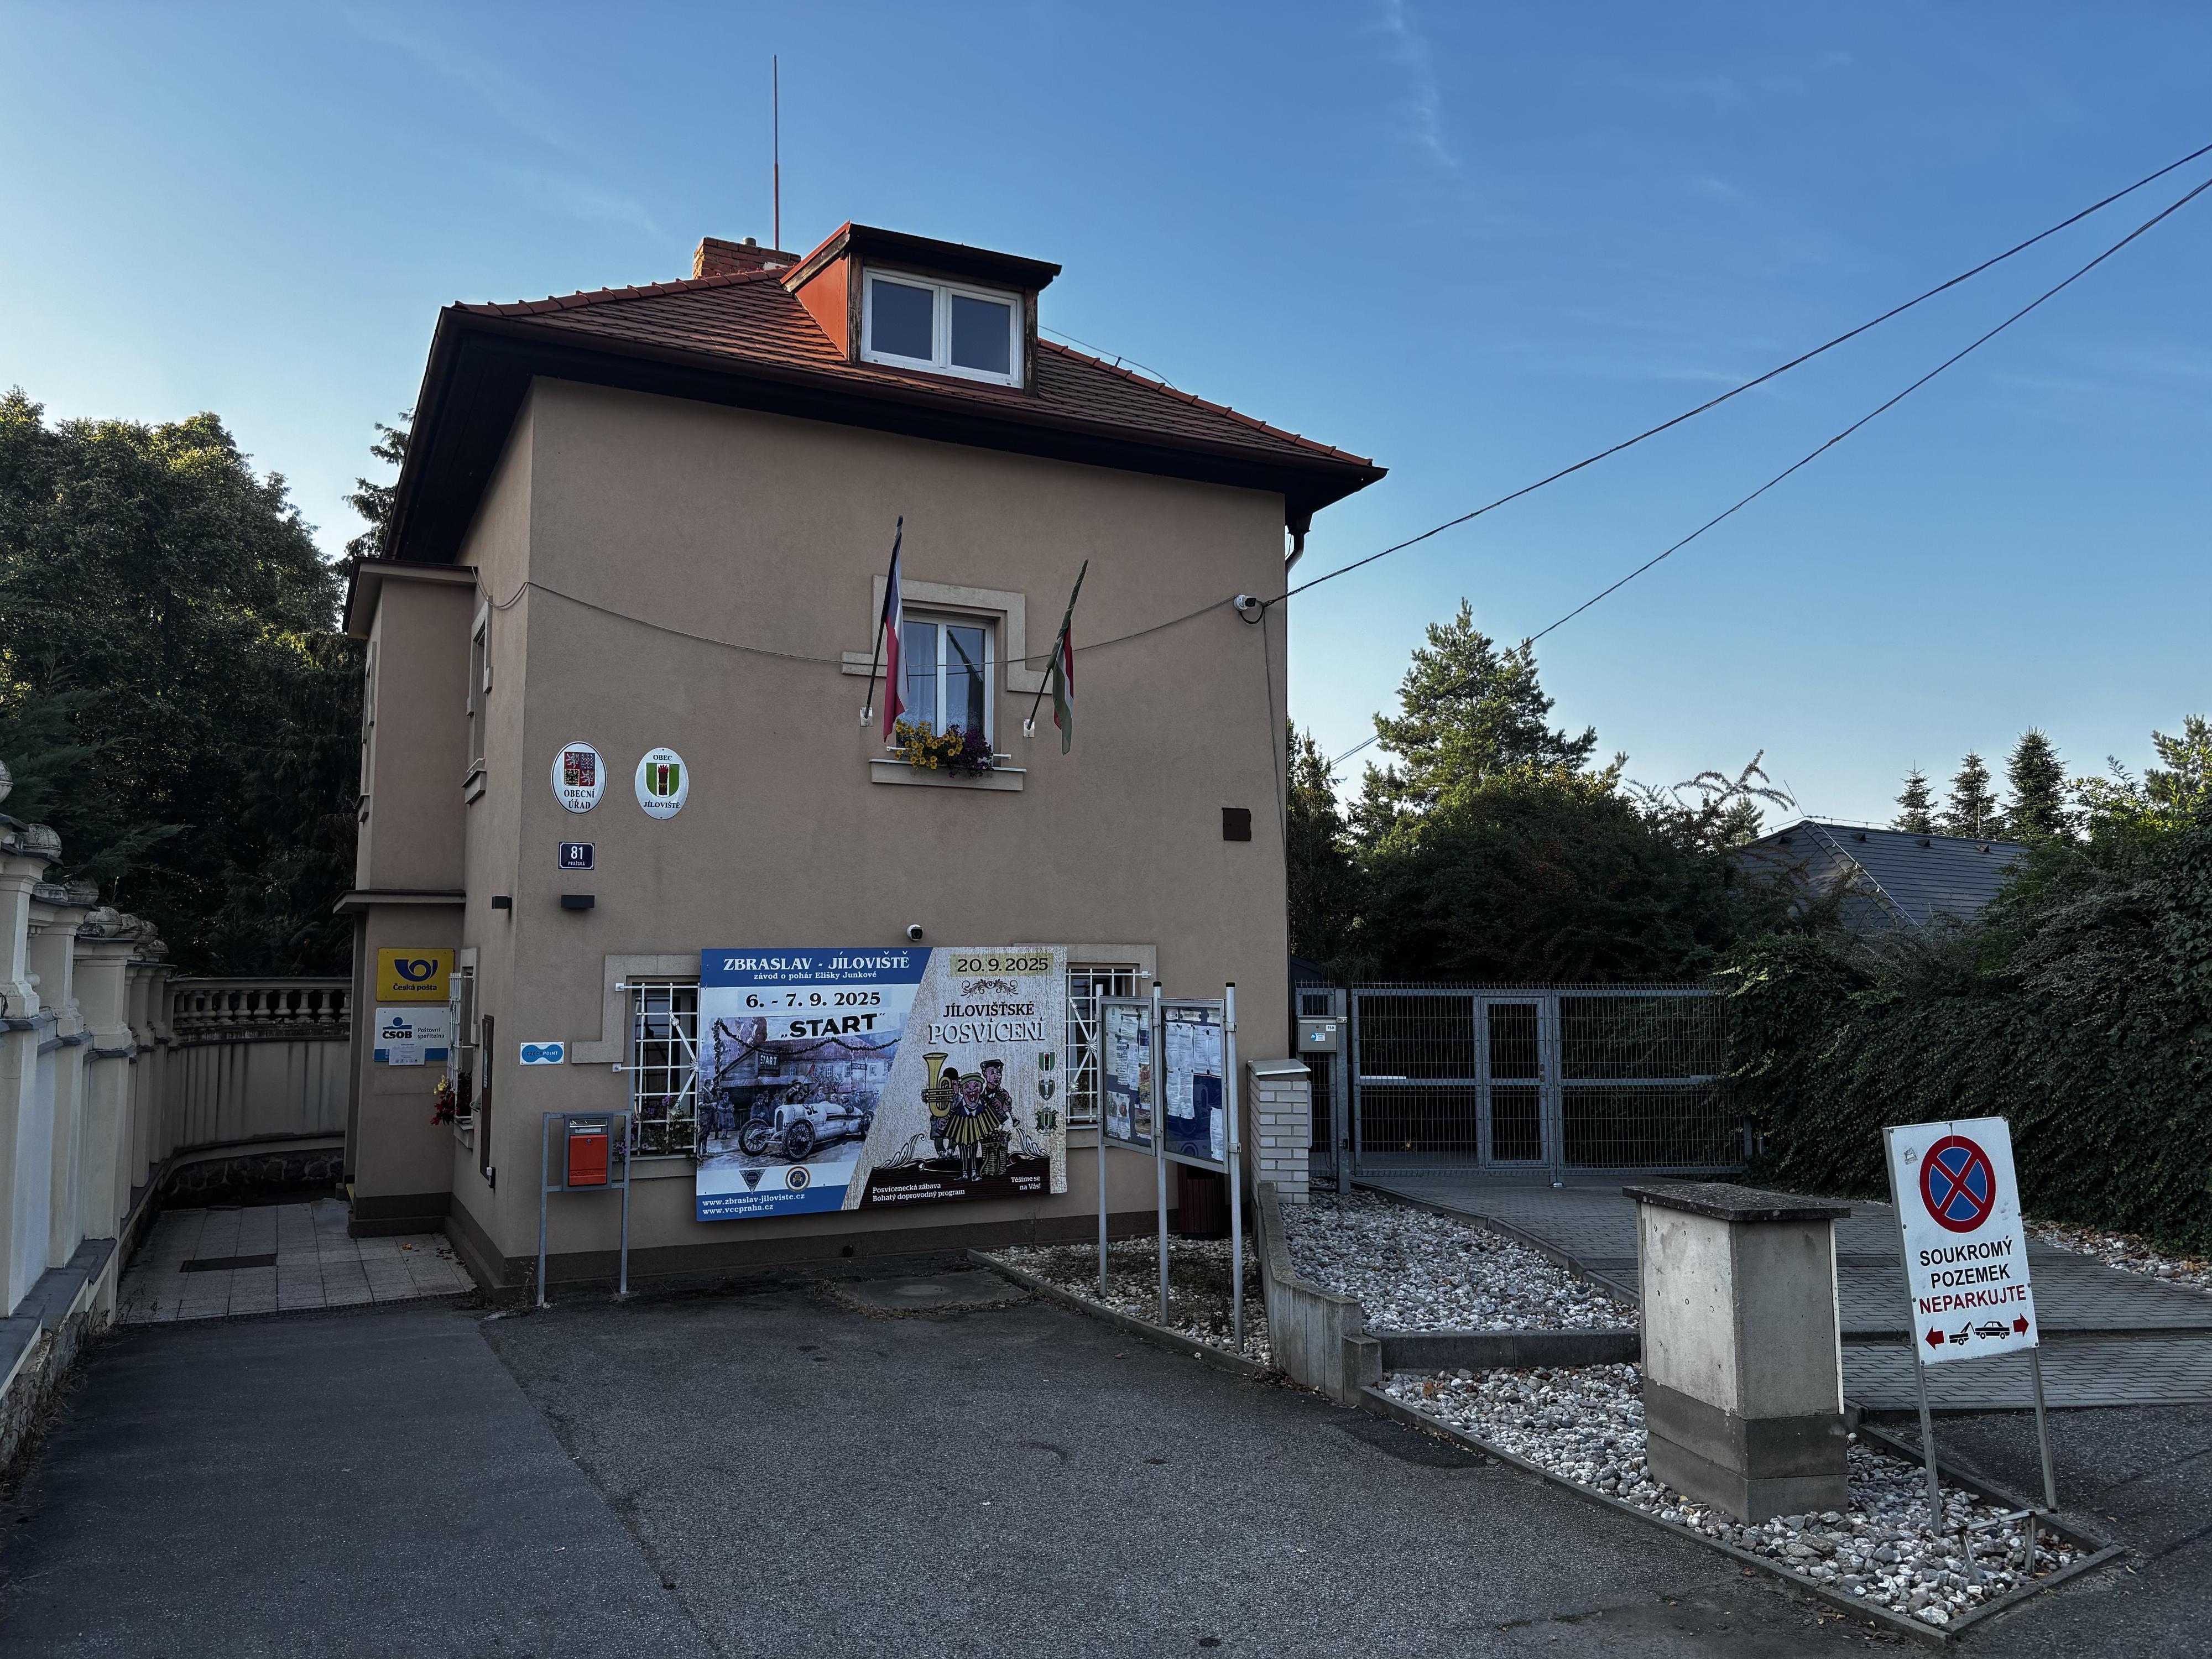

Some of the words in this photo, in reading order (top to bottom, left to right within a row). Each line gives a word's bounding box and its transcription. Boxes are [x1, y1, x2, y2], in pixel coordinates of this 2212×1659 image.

[564, 788, 595, 798] OBECNÍ
[568, 799, 591, 809] ÚŘAD
[643, 800, 680, 808] JÍLOVIŠTĚ
[570, 846, 583, 859] 81
[723, 957, 812, 971] ZBRASLAV
[828, 951, 910, 969] JÍLOVIŠTĚ
[789, 972, 812, 980] pohár
[746, 994, 764, 1008] 6.
[786, 993, 802, 1007] 7.
[809, 993, 827, 1006] 9.
[834, 992, 880, 1006] 2025
[943, 1000, 1034, 1018] JÍLOVIŠŤSKÉ
[382, 1030, 413, 1039] ČSOB
[928, 1017, 1045, 1044] POSVÍCENÍ
[760, 1055, 778, 1066] START
[872, 1183, 918, 1194] Posvícenecká
[872, 1193, 896, 1202] Bohatý
[897, 1190, 937, 1201] doprovodný
[937, 1189, 966, 1198] program
[702, 1204, 774, 1215] www.vccpraha.cz
[1919, 1235, 2013, 1266] SOUKROMÝ
[1931, 1263, 2011, 1289] POZEMEK
[1918, 1284, 2027, 1315] NEPARKUJTE
